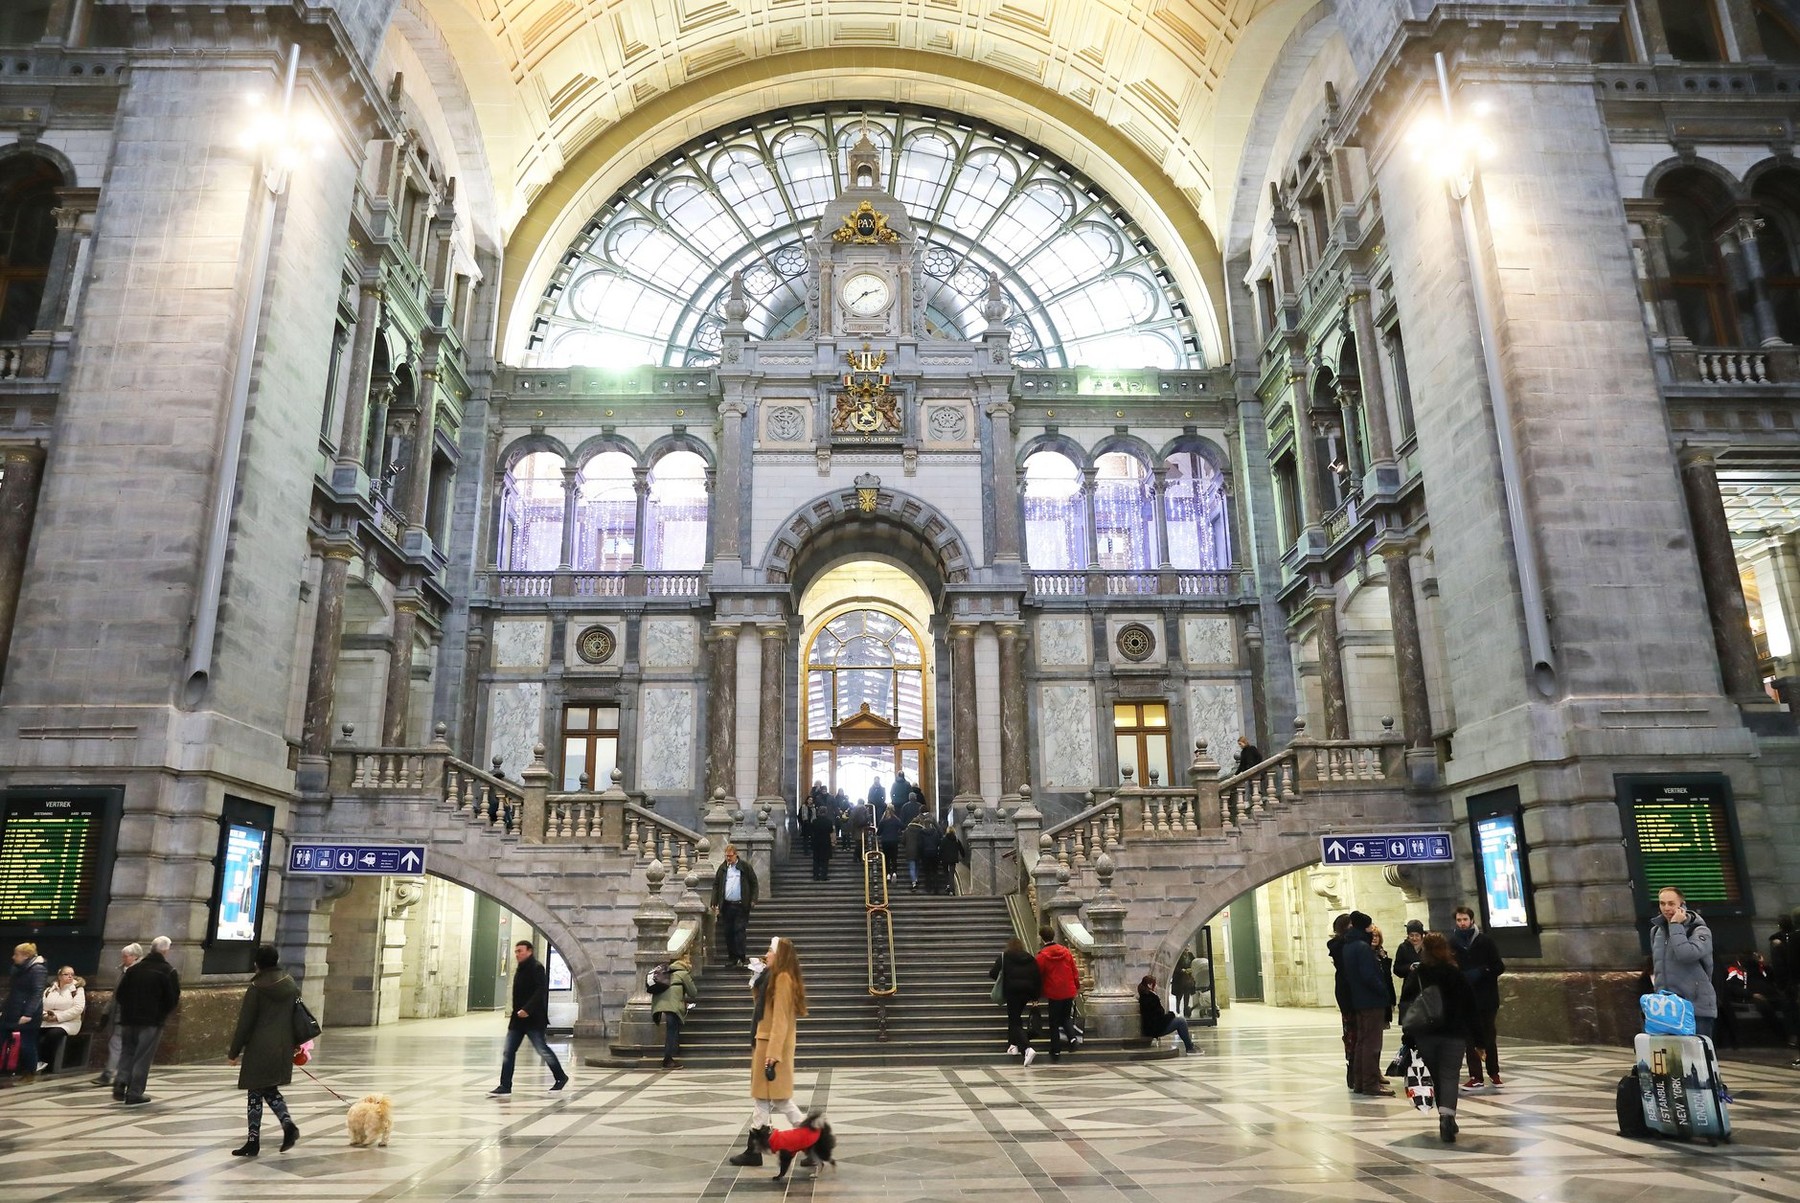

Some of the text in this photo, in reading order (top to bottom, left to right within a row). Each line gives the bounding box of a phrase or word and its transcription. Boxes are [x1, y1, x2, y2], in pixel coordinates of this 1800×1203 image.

[857, 219, 875, 228] PAX
[1656, 1081, 1671, 1123] ISTANBUL
[1671, 1076, 1688, 1125] NEW YORK
[1692, 1092, 1708, 1126] LONDON
